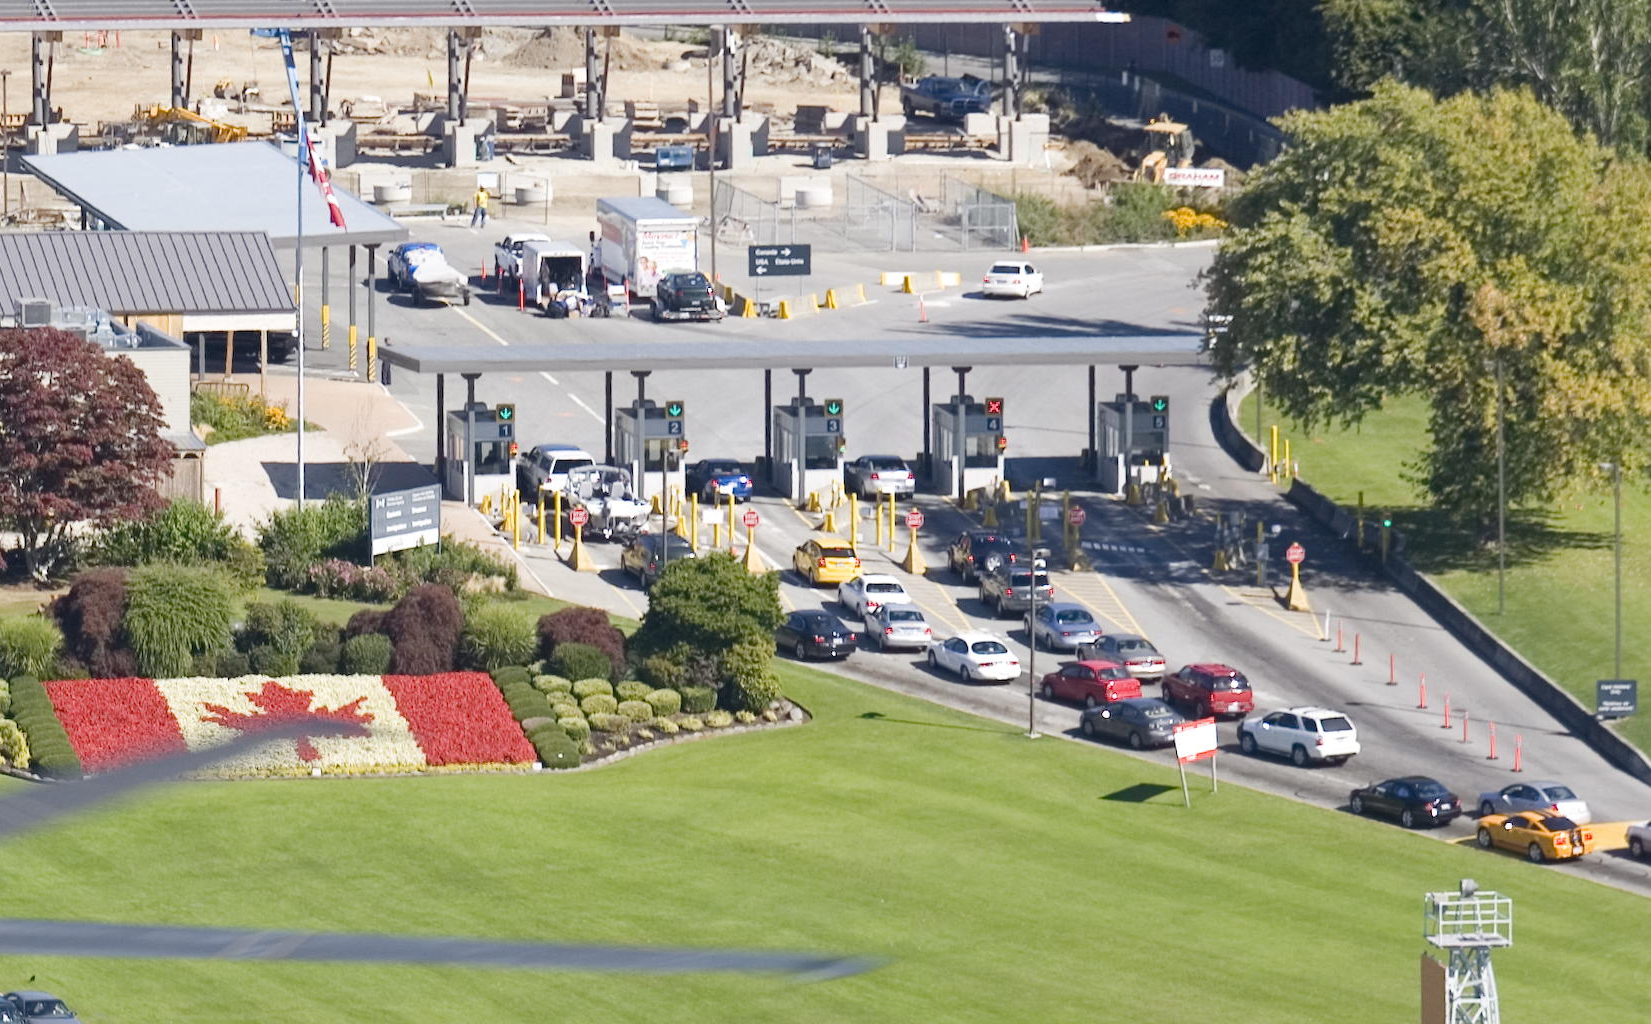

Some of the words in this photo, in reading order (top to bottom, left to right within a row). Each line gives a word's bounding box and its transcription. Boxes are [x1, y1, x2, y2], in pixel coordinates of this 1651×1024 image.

[1169, 172, 1220, 180] GRAHAM
[755, 248, 778, 256] Canada
[755, 258, 769, 266] USA
[671, 422, 679, 433] 2
[830, 420, 838, 431] 3
[990, 419, 998, 430] 4
[1156, 417, 1164, 428] 5
[503, 425, 509, 436] 1
